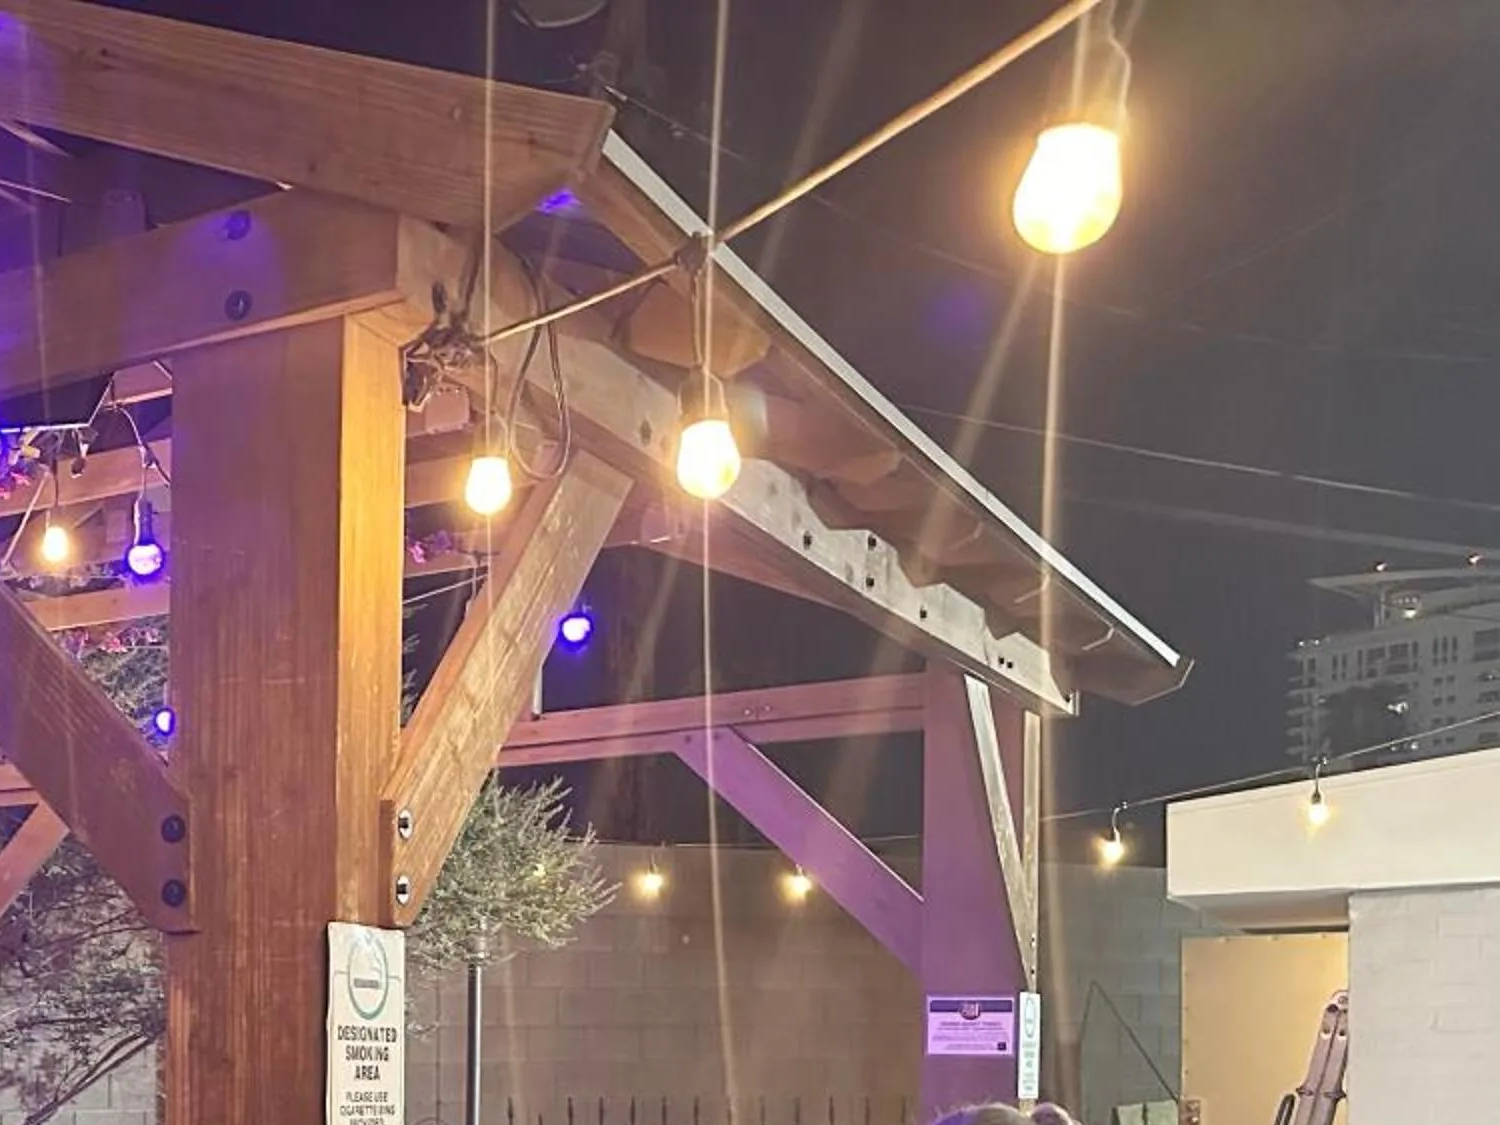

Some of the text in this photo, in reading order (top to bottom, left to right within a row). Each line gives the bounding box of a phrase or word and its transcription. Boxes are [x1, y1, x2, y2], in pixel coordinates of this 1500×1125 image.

[337, 1024, 397, 1043] DESIGNATED
[345, 1045, 389, 1061] SMOKING
[354, 1065, 381, 1081] AREA
